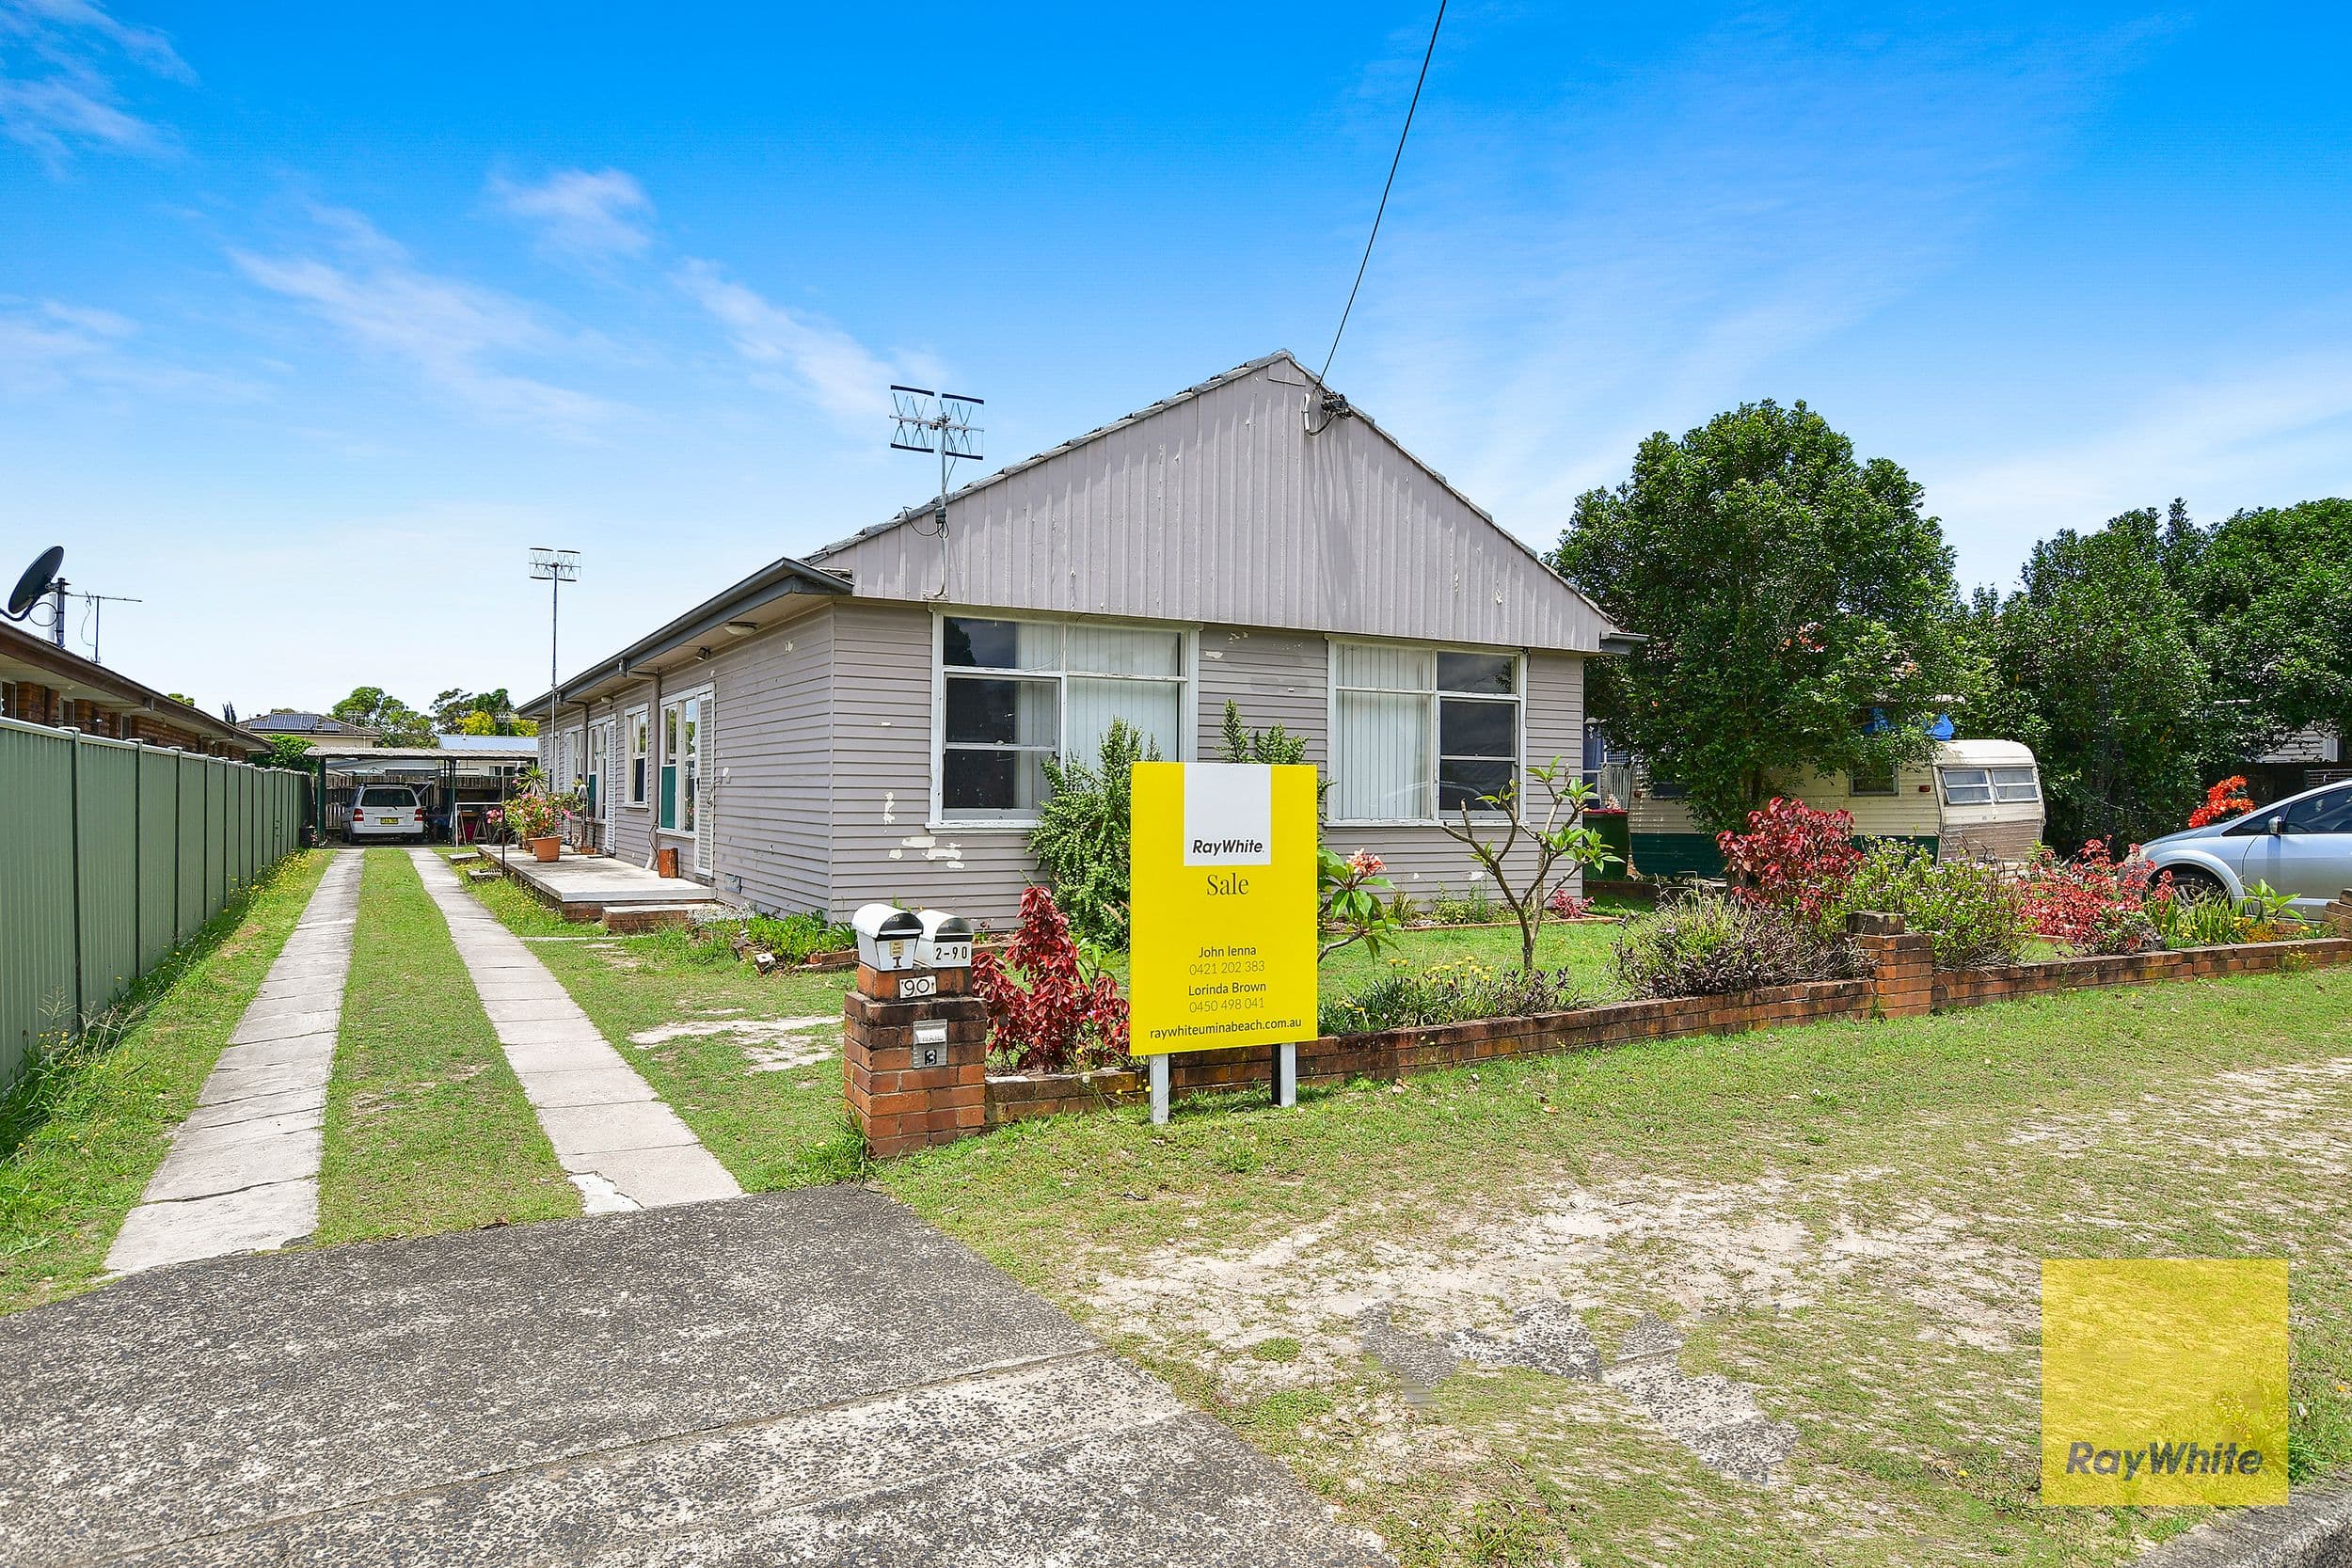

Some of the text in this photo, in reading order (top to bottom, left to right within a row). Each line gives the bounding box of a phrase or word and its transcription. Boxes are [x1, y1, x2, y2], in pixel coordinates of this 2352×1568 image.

[1207, 872, 1249, 895] Sale
[935, 946, 968, 960] 2-90
[1199, 946, 1224, 958] John
[1189, 960, 1265, 976] 0421 202 383
[904, 979, 930, 997] 90
[1188, 982, 1267, 996] Lorinda Brown
[1189, 997, 1265, 1013] 0450 498 041
[1150, 1018, 1302, 1039] raywhiteuminabeach.com.au
